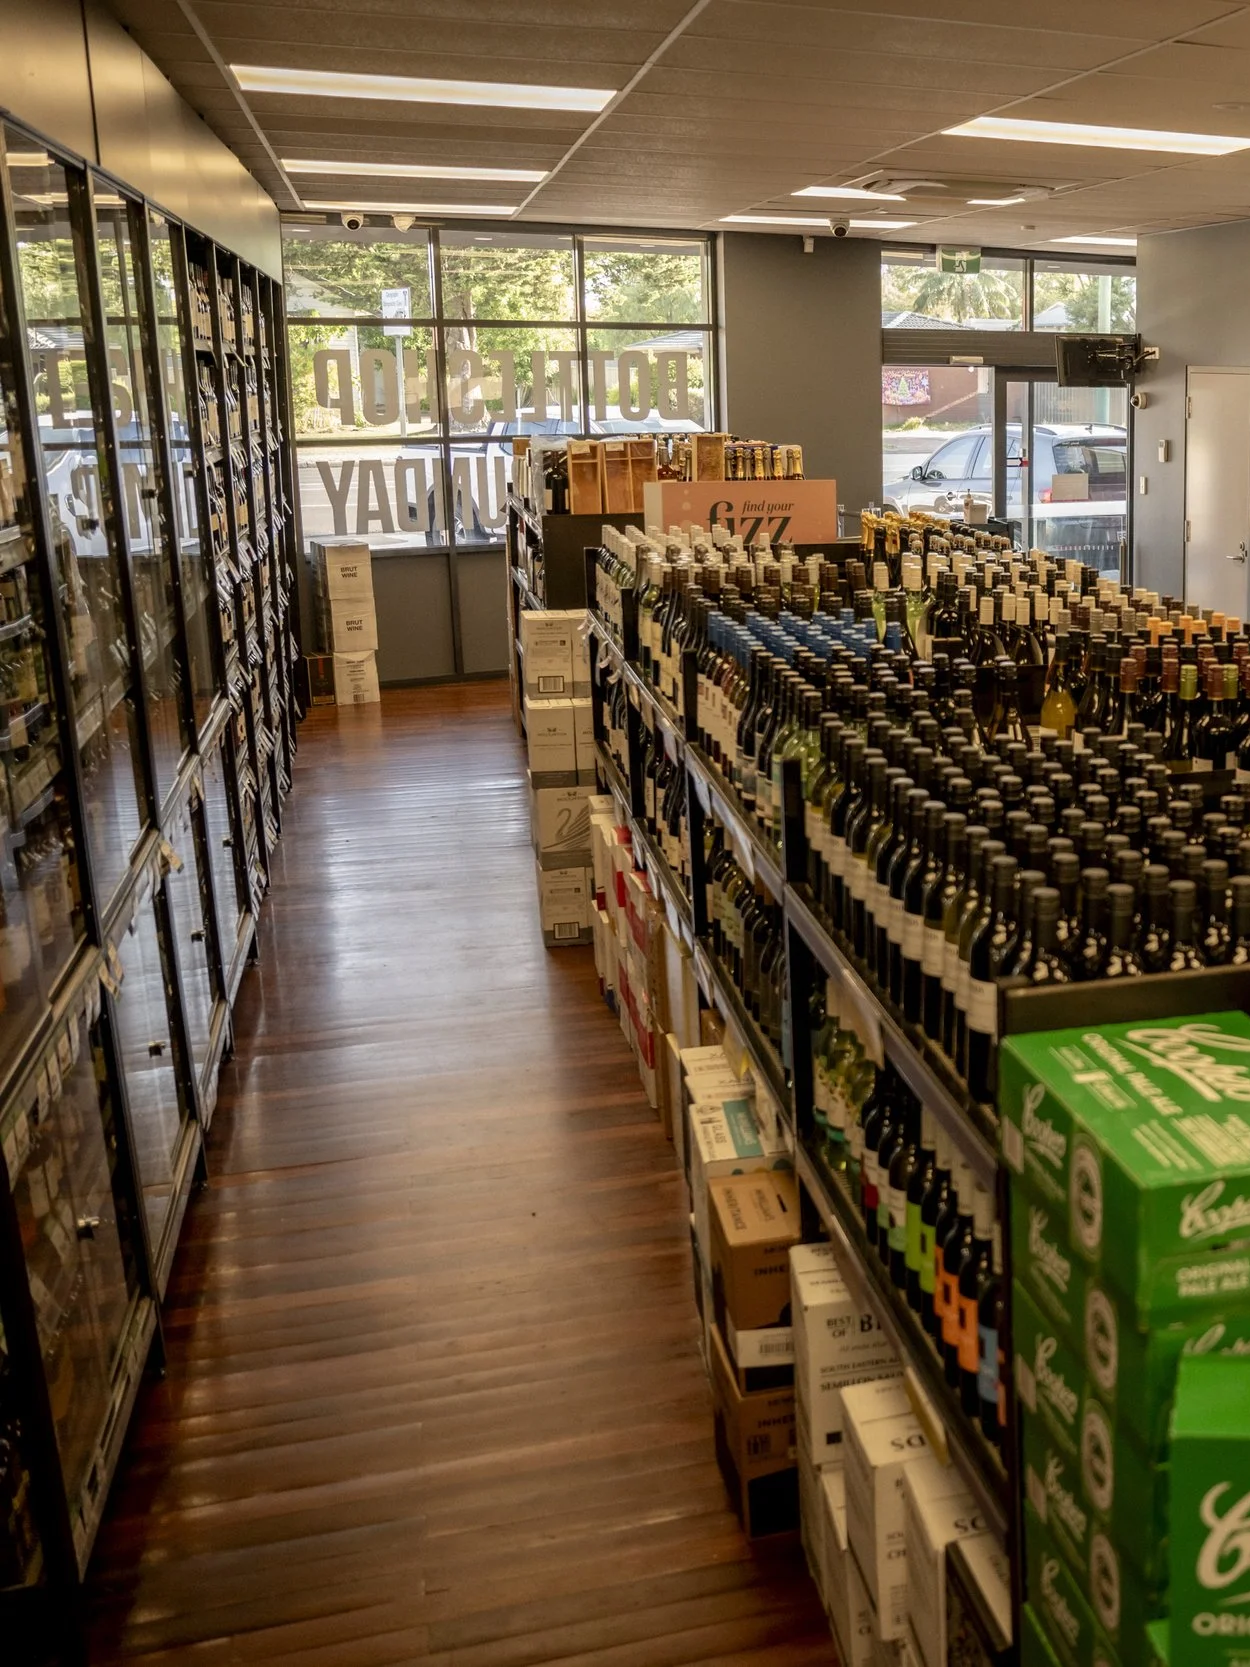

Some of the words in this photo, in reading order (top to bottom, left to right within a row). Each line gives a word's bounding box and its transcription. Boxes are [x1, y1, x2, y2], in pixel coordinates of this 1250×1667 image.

[741, 500, 765, 516] find
[767, 502, 795, 519] your
[1176, 1259, 1250, 1283] ORIGINAL
[1179, 1278, 1217, 1298] PALE
[1220, 1274, 1250, 1293] ALE
[827, 1315, 851, 1327] BEST
[832, 1329, 846, 1338] OF
